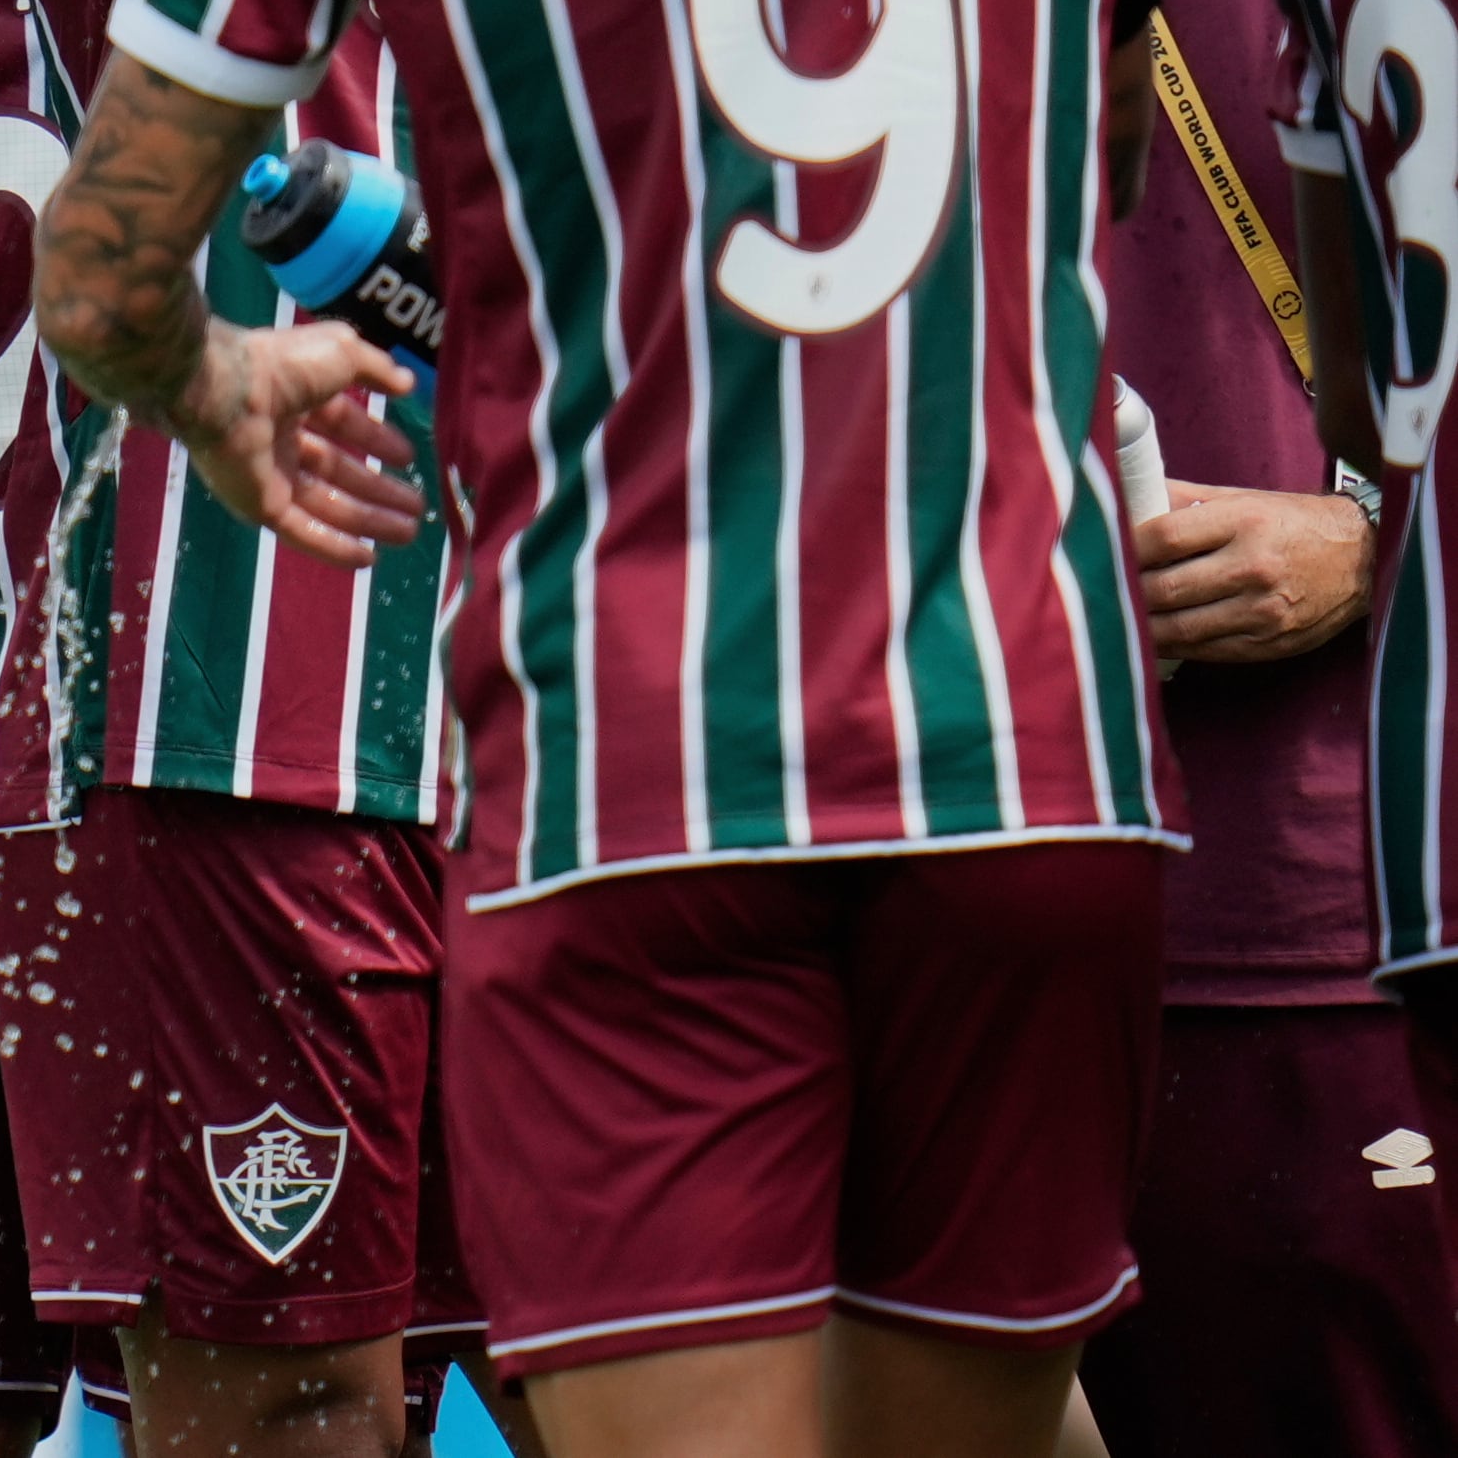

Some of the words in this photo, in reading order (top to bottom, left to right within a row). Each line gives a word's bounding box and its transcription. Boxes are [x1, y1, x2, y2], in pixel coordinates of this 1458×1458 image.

[1160, 62, 1184, 97] CUP
[1179, 99, 1216, 164] WORLD
[1209, 164, 1239, 209] CLUB
[1234, 209, 1262, 249] FIFA
